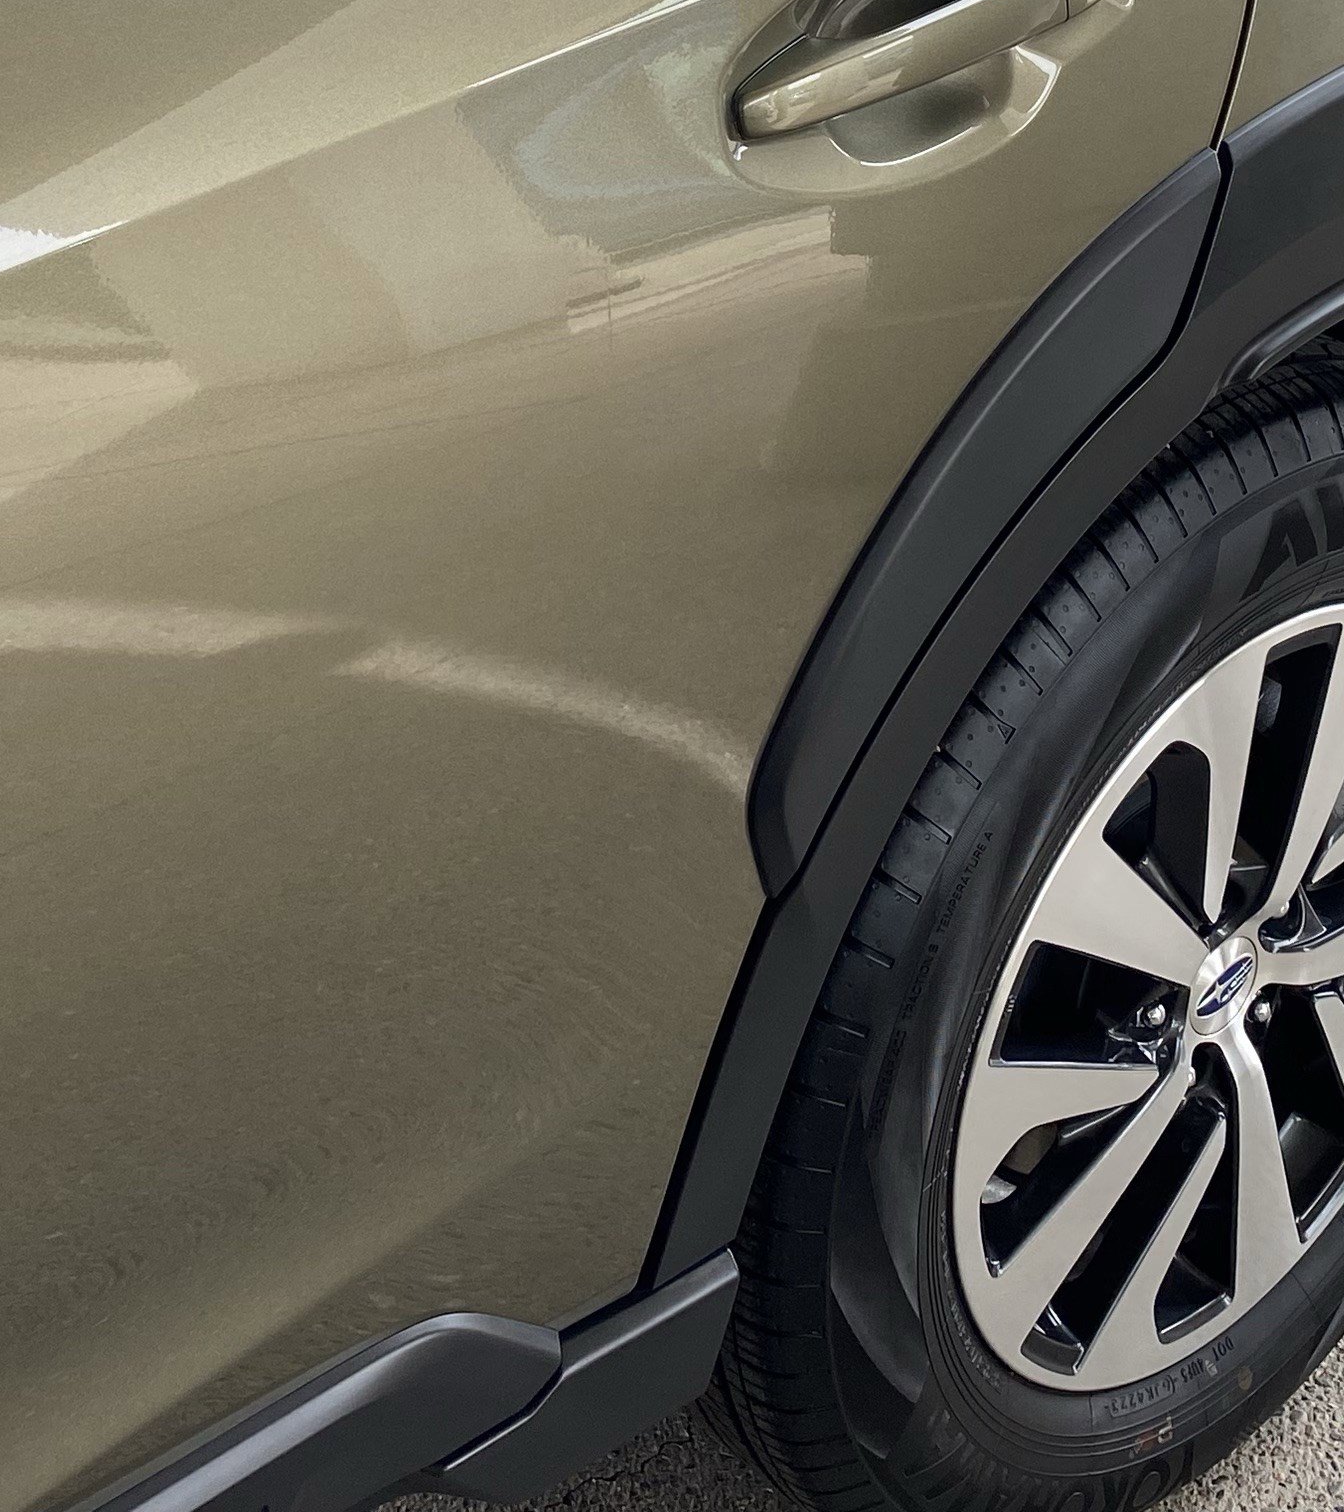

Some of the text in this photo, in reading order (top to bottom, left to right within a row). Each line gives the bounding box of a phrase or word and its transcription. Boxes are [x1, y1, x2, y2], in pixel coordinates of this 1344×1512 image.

[902, 957, 932, 1021] TRACTION
[936, 843, 988, 934] TEMPERATURE
[984, 830, 994, 841] A
[1211, 1336, 1235, 1362] DOT
